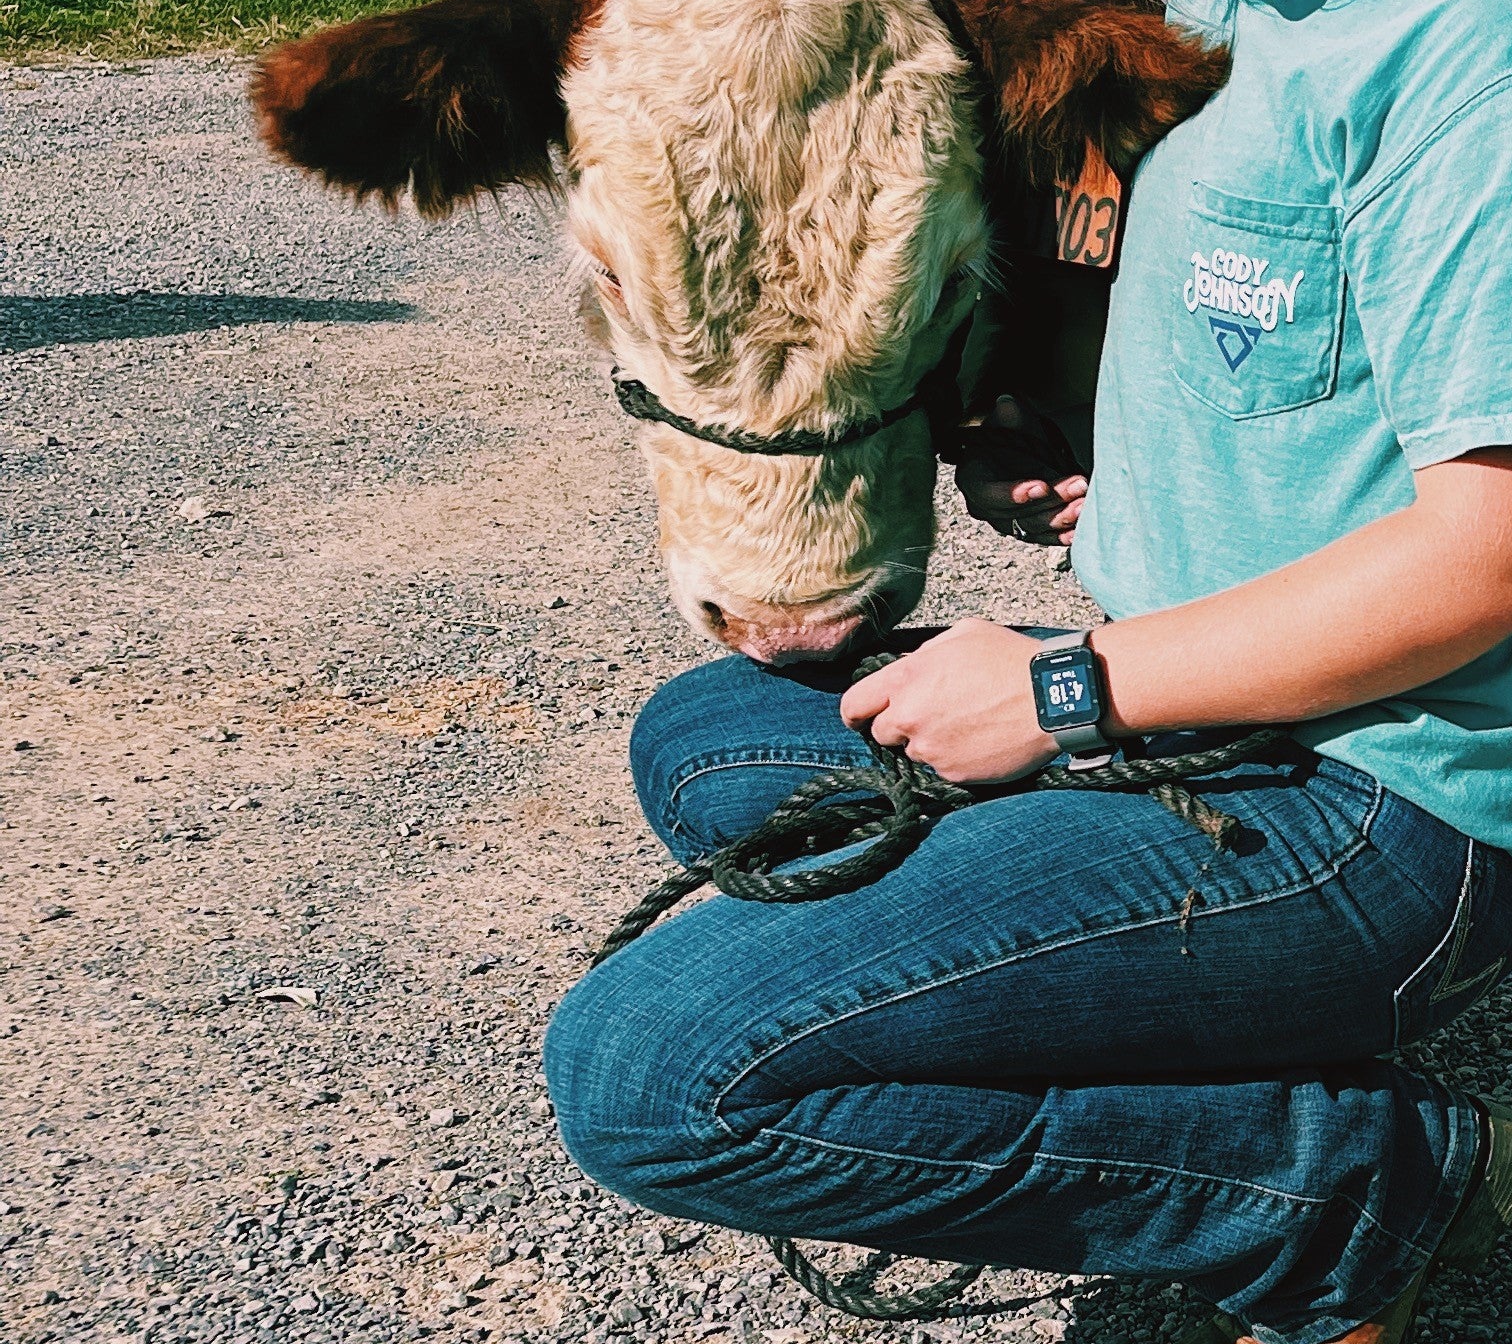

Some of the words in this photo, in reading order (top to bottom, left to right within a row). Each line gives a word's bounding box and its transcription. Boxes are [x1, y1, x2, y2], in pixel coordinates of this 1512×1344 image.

[1211, 247, 1269, 286] CODY
[1183, 251, 1305, 332] JOHNSON
[1048, 680, 1084, 705] 4:18
